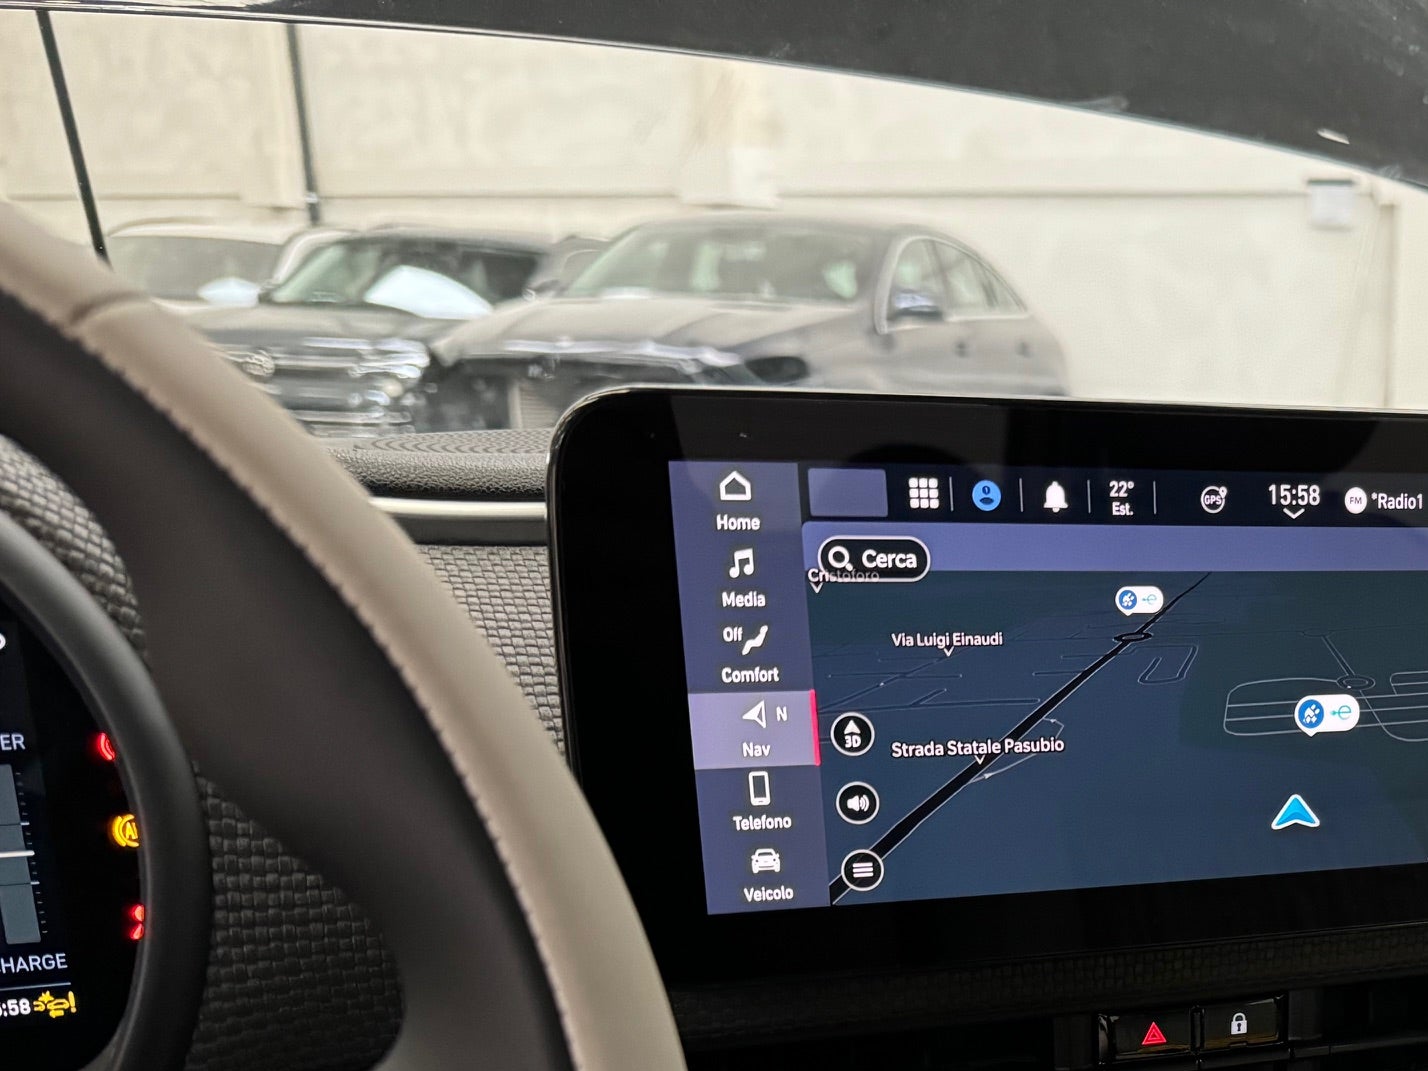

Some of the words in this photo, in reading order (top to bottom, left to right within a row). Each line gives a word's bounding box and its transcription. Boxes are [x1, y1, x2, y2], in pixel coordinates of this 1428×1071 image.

[1268, 484, 1321, 506] 15:58
[1349, 496, 1363, 505] FM
[1112, 501, 1134, 516] Est.
[716, 513, 761, 531] Home
[861, 549, 918, 568] Cerca
[721, 590, 766, 608] Media
[722, 626, 743, 642] Off
[891, 632, 915, 647] Via
[916, 632, 950, 651] Luigi
[952, 631, 1003, 646] Einaudi
[721, 666, 780, 683] Comfort
[776, 706, 788, 722] N
[742, 742, 771, 757] Nav
[844, 734, 862, 748] 3D
[891, 741, 945, 758] Strada
[947, 740, 1001, 756] Statale
[1004, 738, 1065, 754] Pasubio
[732, 814, 792, 831] Telefono
[743, 885, 794, 903] Veicolo
[0, 953, 68, 974] HARGE
